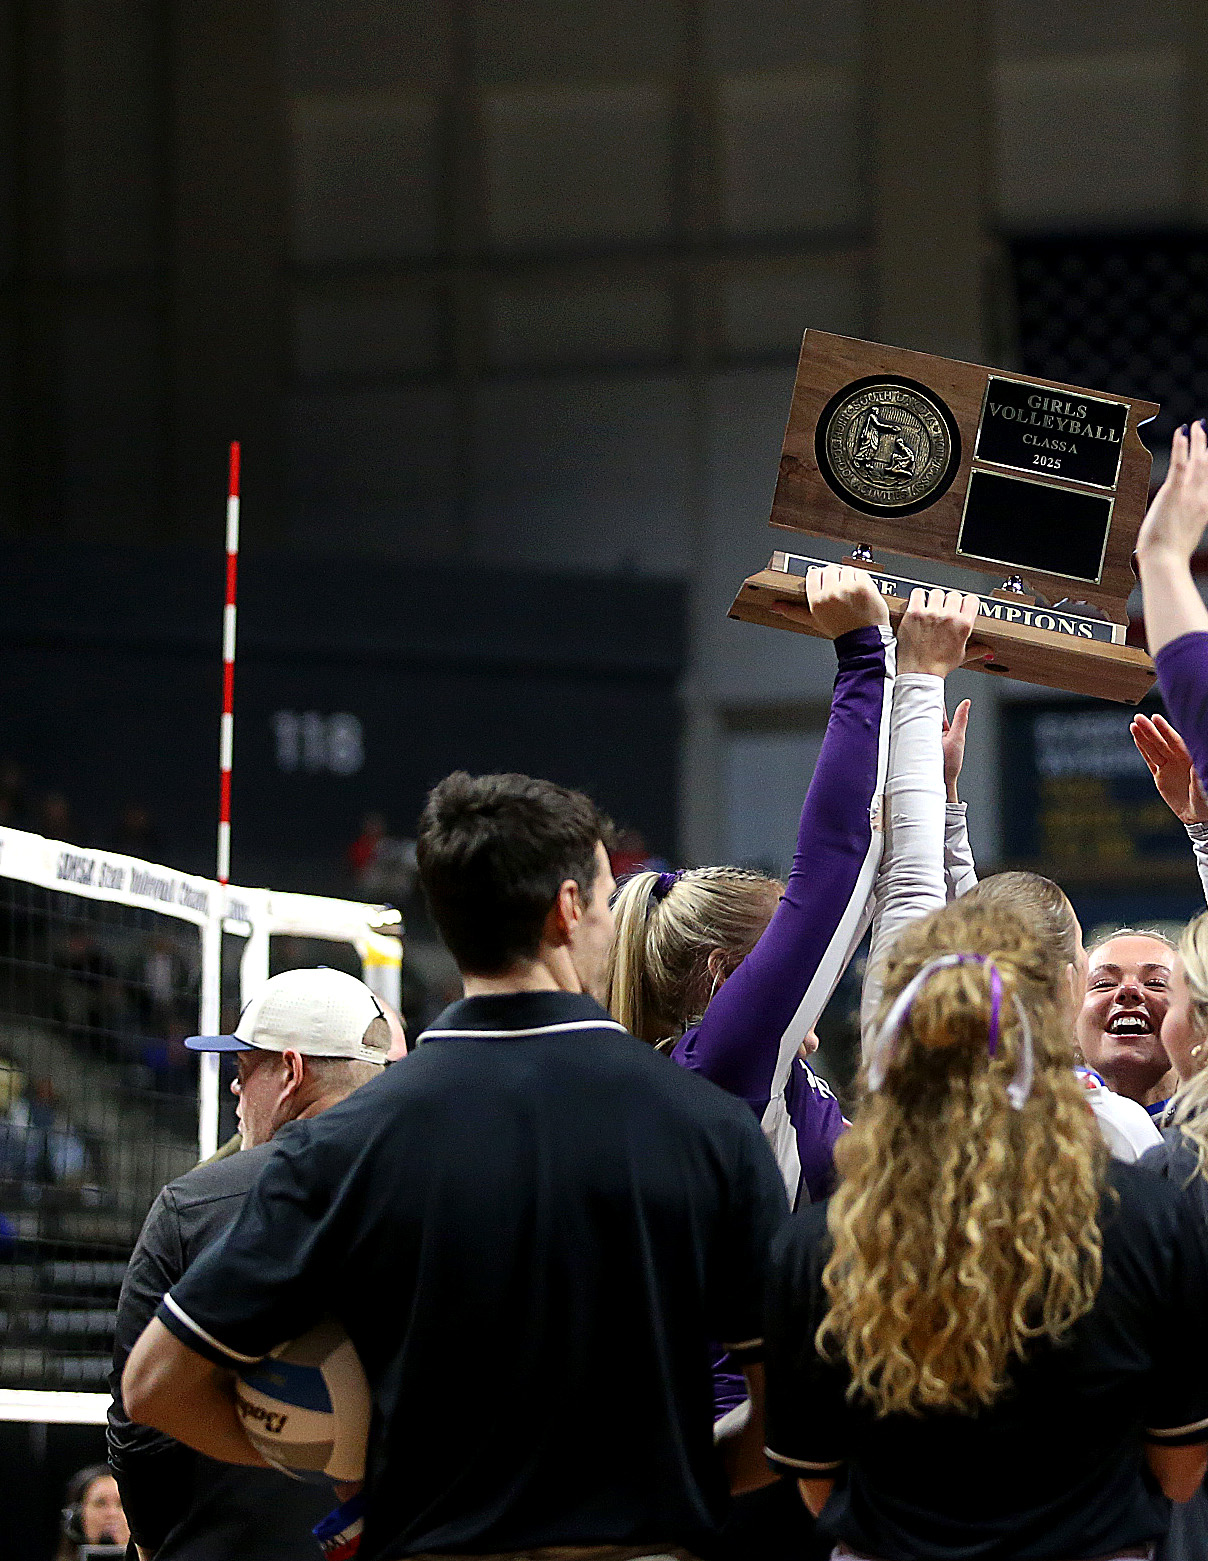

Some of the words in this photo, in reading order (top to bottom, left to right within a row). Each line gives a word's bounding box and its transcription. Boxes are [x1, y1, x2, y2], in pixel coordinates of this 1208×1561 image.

[989, 402, 1120, 443] VOLLEYBALL
[1027, 394, 1088, 419] GIRLS
[1022, 433, 1067, 452] CLASS
[1068, 444, 1078, 455] A
[1032, 454, 1062, 470] 2025
[978, 600, 1094, 639] MPIONS
[274, 709, 366, 775] 118
